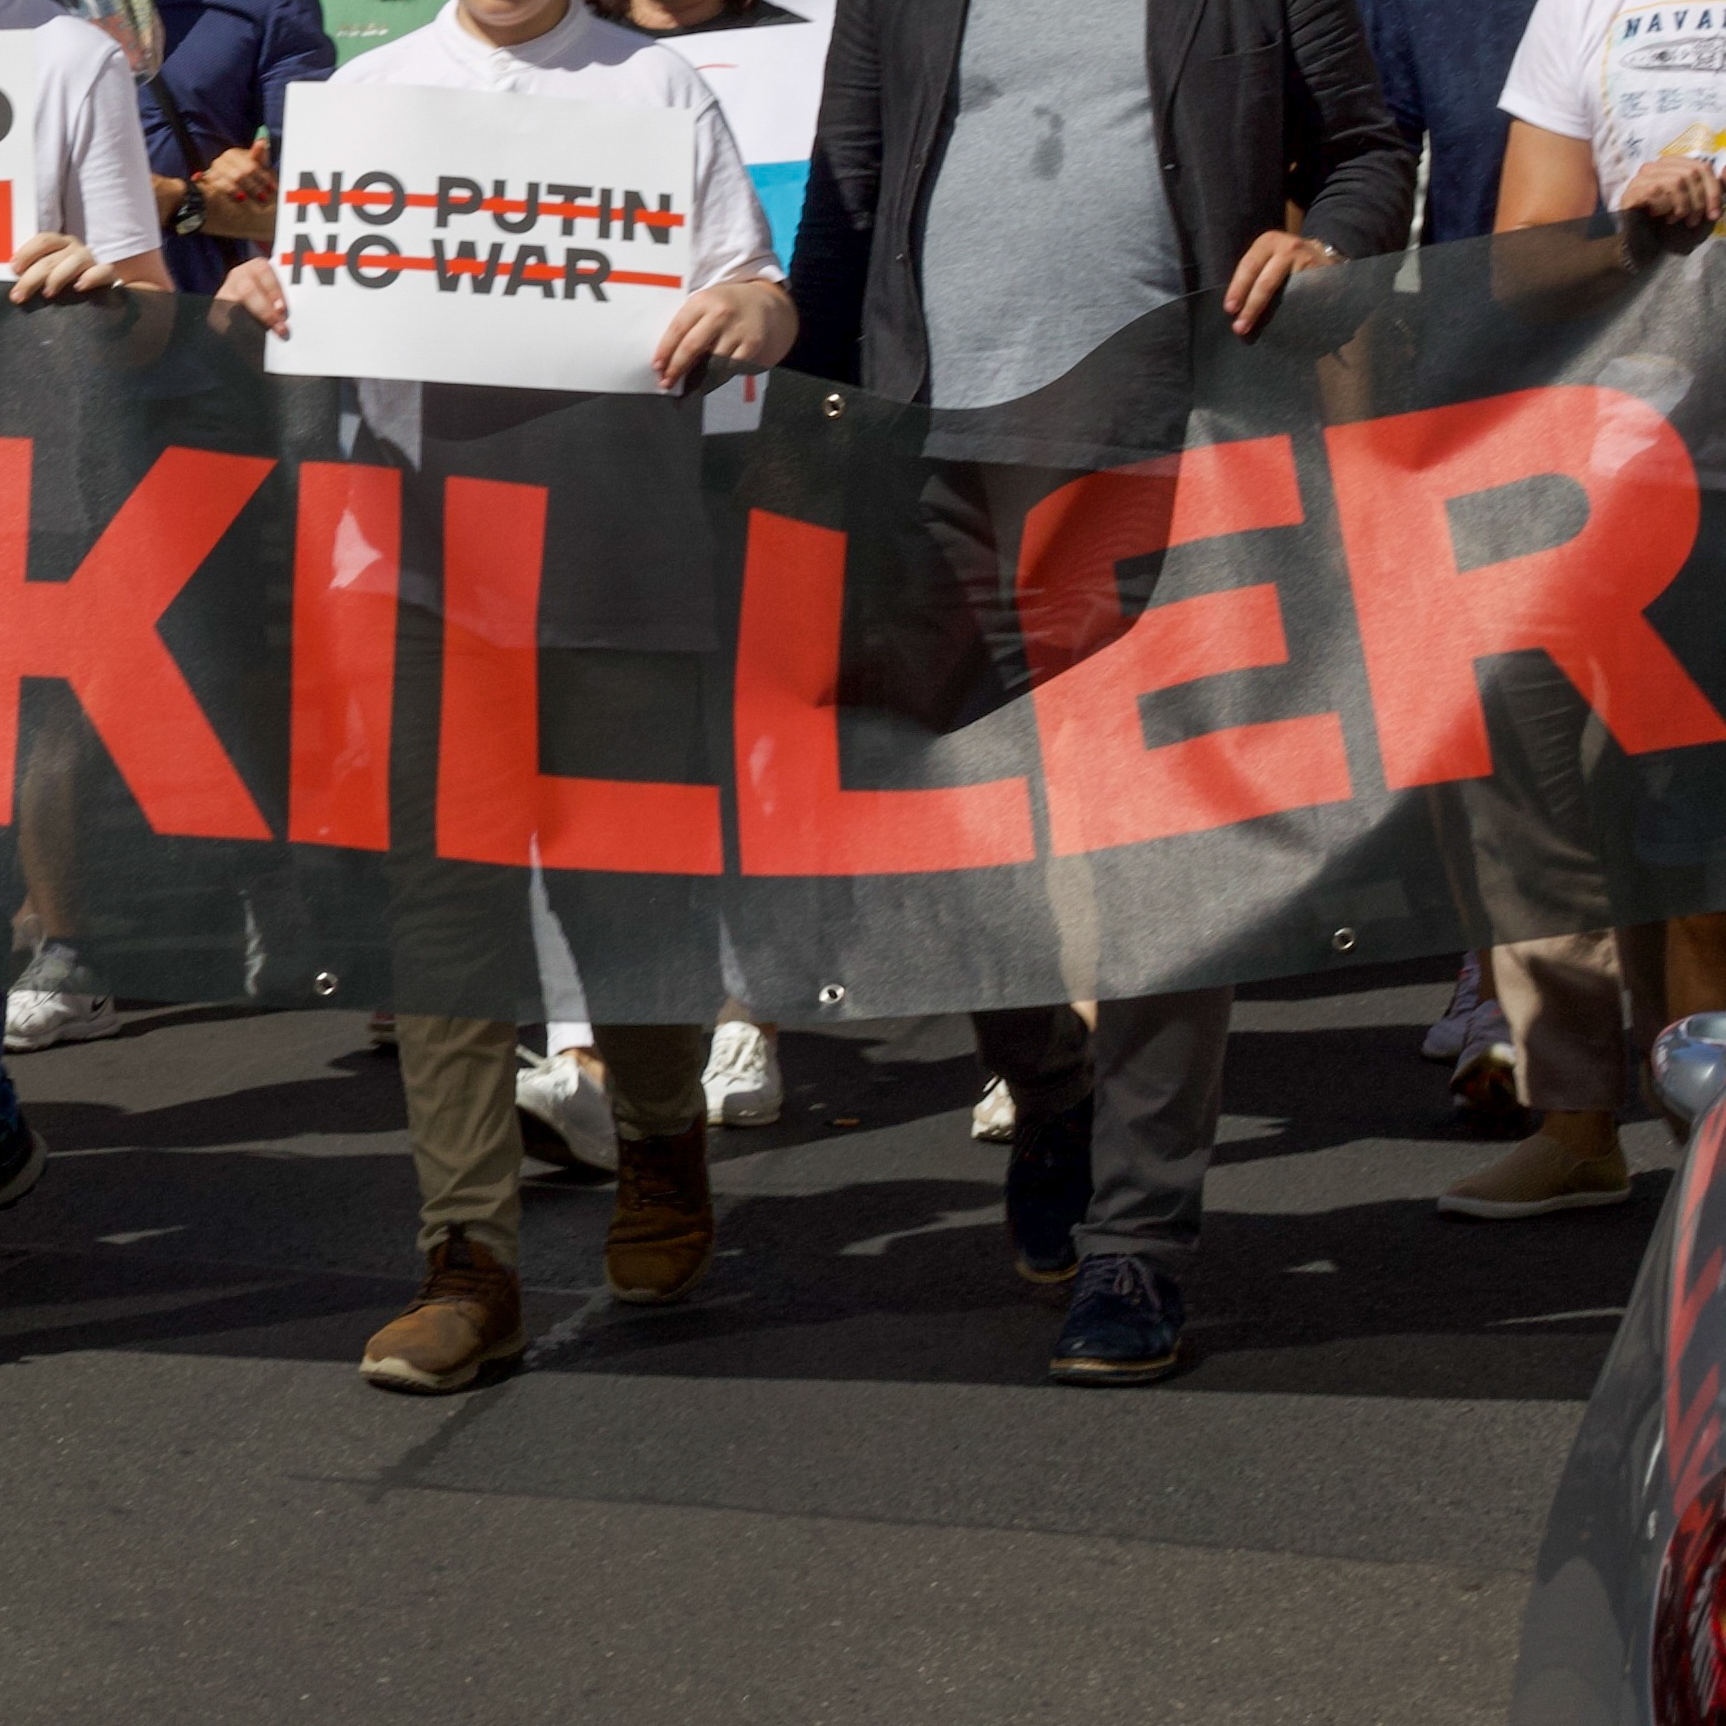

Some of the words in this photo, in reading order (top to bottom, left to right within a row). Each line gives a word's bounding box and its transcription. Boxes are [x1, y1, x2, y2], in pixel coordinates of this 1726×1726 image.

[1622, 8, 1726, 40] NAVA
[295, 170, 406, 226] NO
[435, 175, 673, 245] PUTIN
[290, 234, 402, 289] NO
[431, 238, 613, 302] WAR
